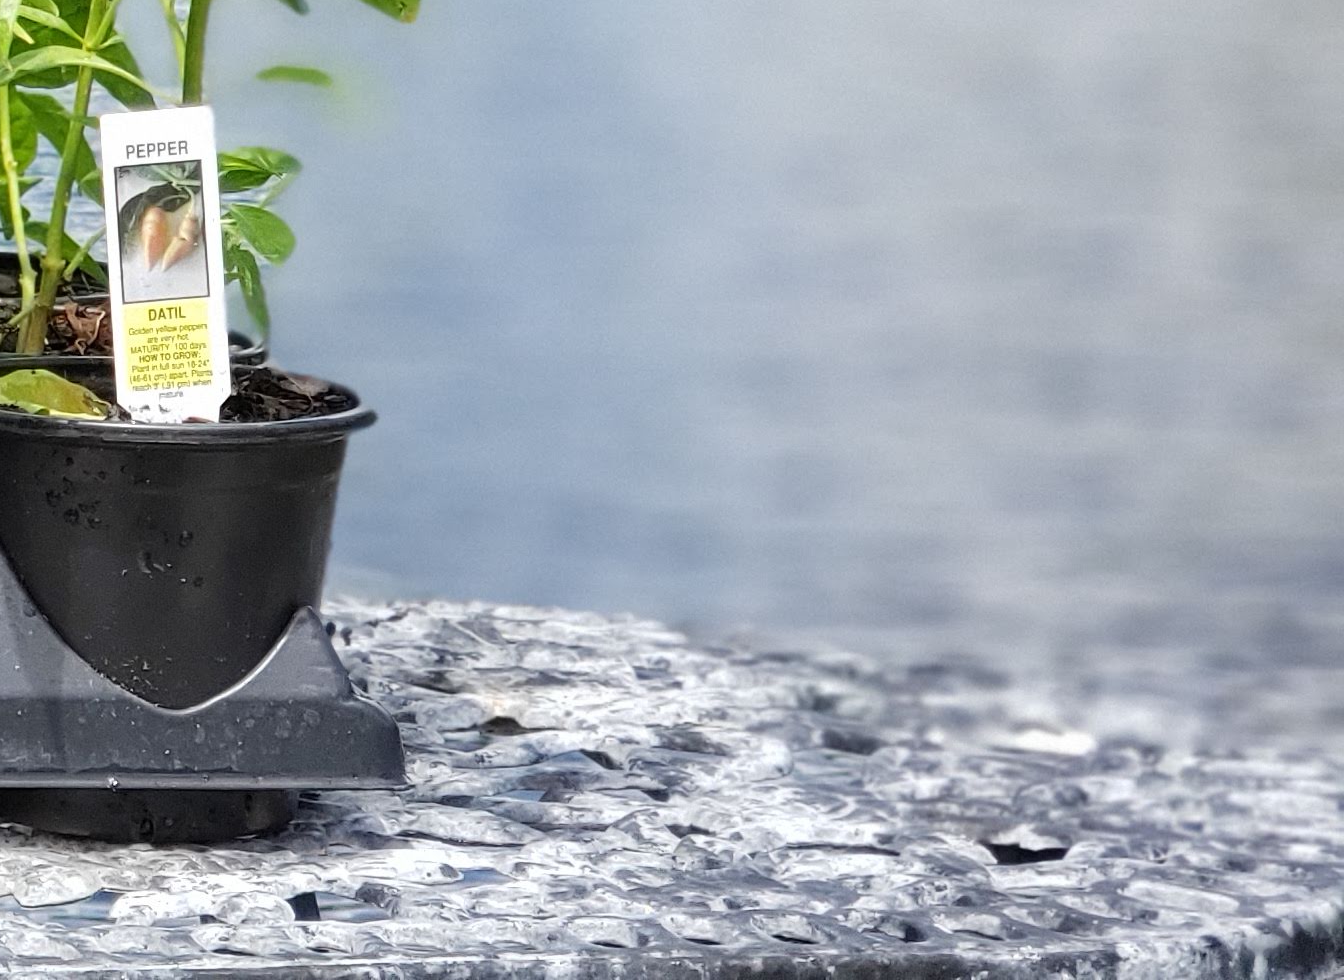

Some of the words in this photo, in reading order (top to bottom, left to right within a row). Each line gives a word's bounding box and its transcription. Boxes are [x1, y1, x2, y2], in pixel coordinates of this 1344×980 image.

[126, 140, 188, 159] PEPPER
[149, 306, 186, 321] DATIL
[161, 335, 174, 343] very
[139, 355, 157, 363] HOW
[160, 353, 171, 361] TO
